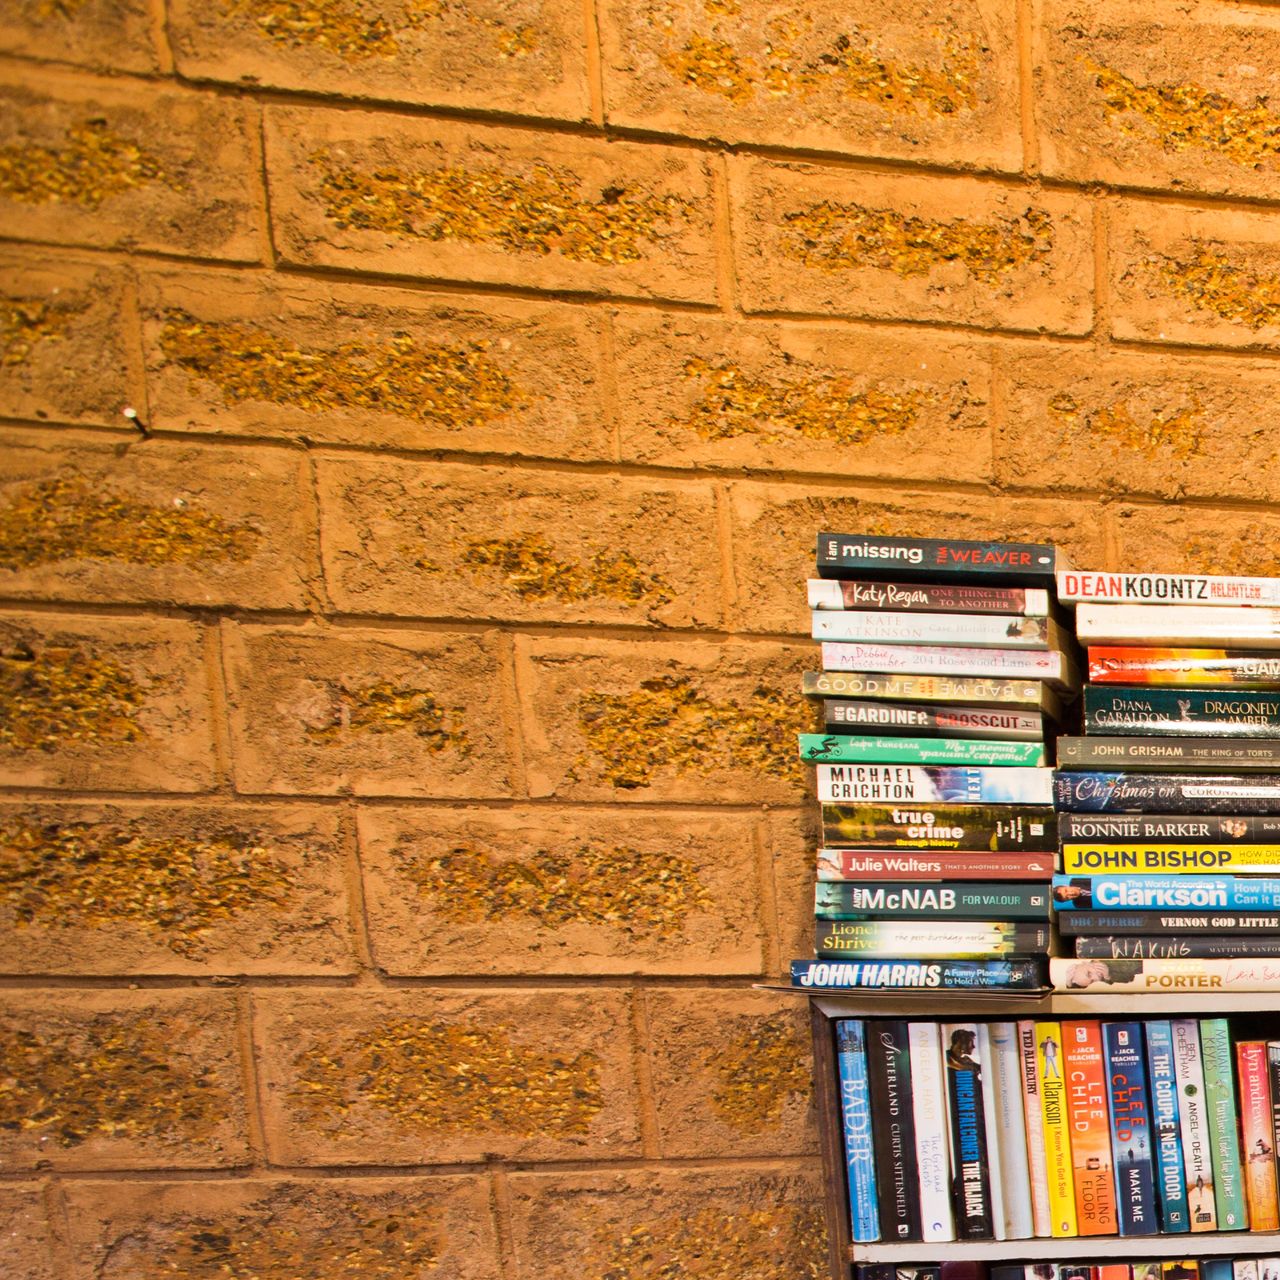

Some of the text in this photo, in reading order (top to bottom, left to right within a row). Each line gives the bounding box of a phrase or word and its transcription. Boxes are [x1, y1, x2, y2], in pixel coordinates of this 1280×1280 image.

[843, 543, 923, 563] missing
[951, 550, 1031, 565] WEAVER
[853, 584, 928, 607] Katy Regan
[958, 600, 1008, 609] ANOTHER
[939, 656, 1031, 668] Rosewood Lane
[817, 679, 913, 693] GOOD ME
[1204, 702, 1279, 714] DRAGONFLY
[846, 708, 928, 725] GARDINER
[1092, 746, 1182, 756] JOHN GRISHAM
[830, 768, 915, 783] MICHAEL
[831, 783, 914, 799] CRICHTON
[968, 769, 982, 800] NEXT
[892, 809, 936, 824] true
[908, 826, 964, 839] crime
[1071, 825, 1210, 837] RONNIE BARKER
[849, 858, 941, 872] Julie Walters
[1072, 851, 1231, 868] JOHN BISHOP
[1097, 882, 1227, 906] Clarkson
[1234, 884, 1259, 894] How
[862, 890, 956, 909] McNAB
[963, 896, 1020, 905] FOR VALOUR
[1234, 894, 1258, 905] Can
[1261, 895, 1269, 905] it
[1161, 918, 1278, 928] VERNON GOD LITTLE
[1111, 941, 1190, 958] WAKING
[801, 964, 941, 986] JOHN HARRIS
[1145, 975, 1222, 987] PORTER
[1044, 1081, 1062, 1125] Clarkson
[1071, 1071, 1089, 1132] CHILD
[1088, 1083, 1103, 1118] LEE
[843, 1079, 869, 1166] BADER
[1154, 1055, 1180, 1201] THE COUPLE NEXT DOOR
[962, 1162, 983, 1217] THE HIJACK
[1129, 1169, 1143, 1222] MAKE ME
